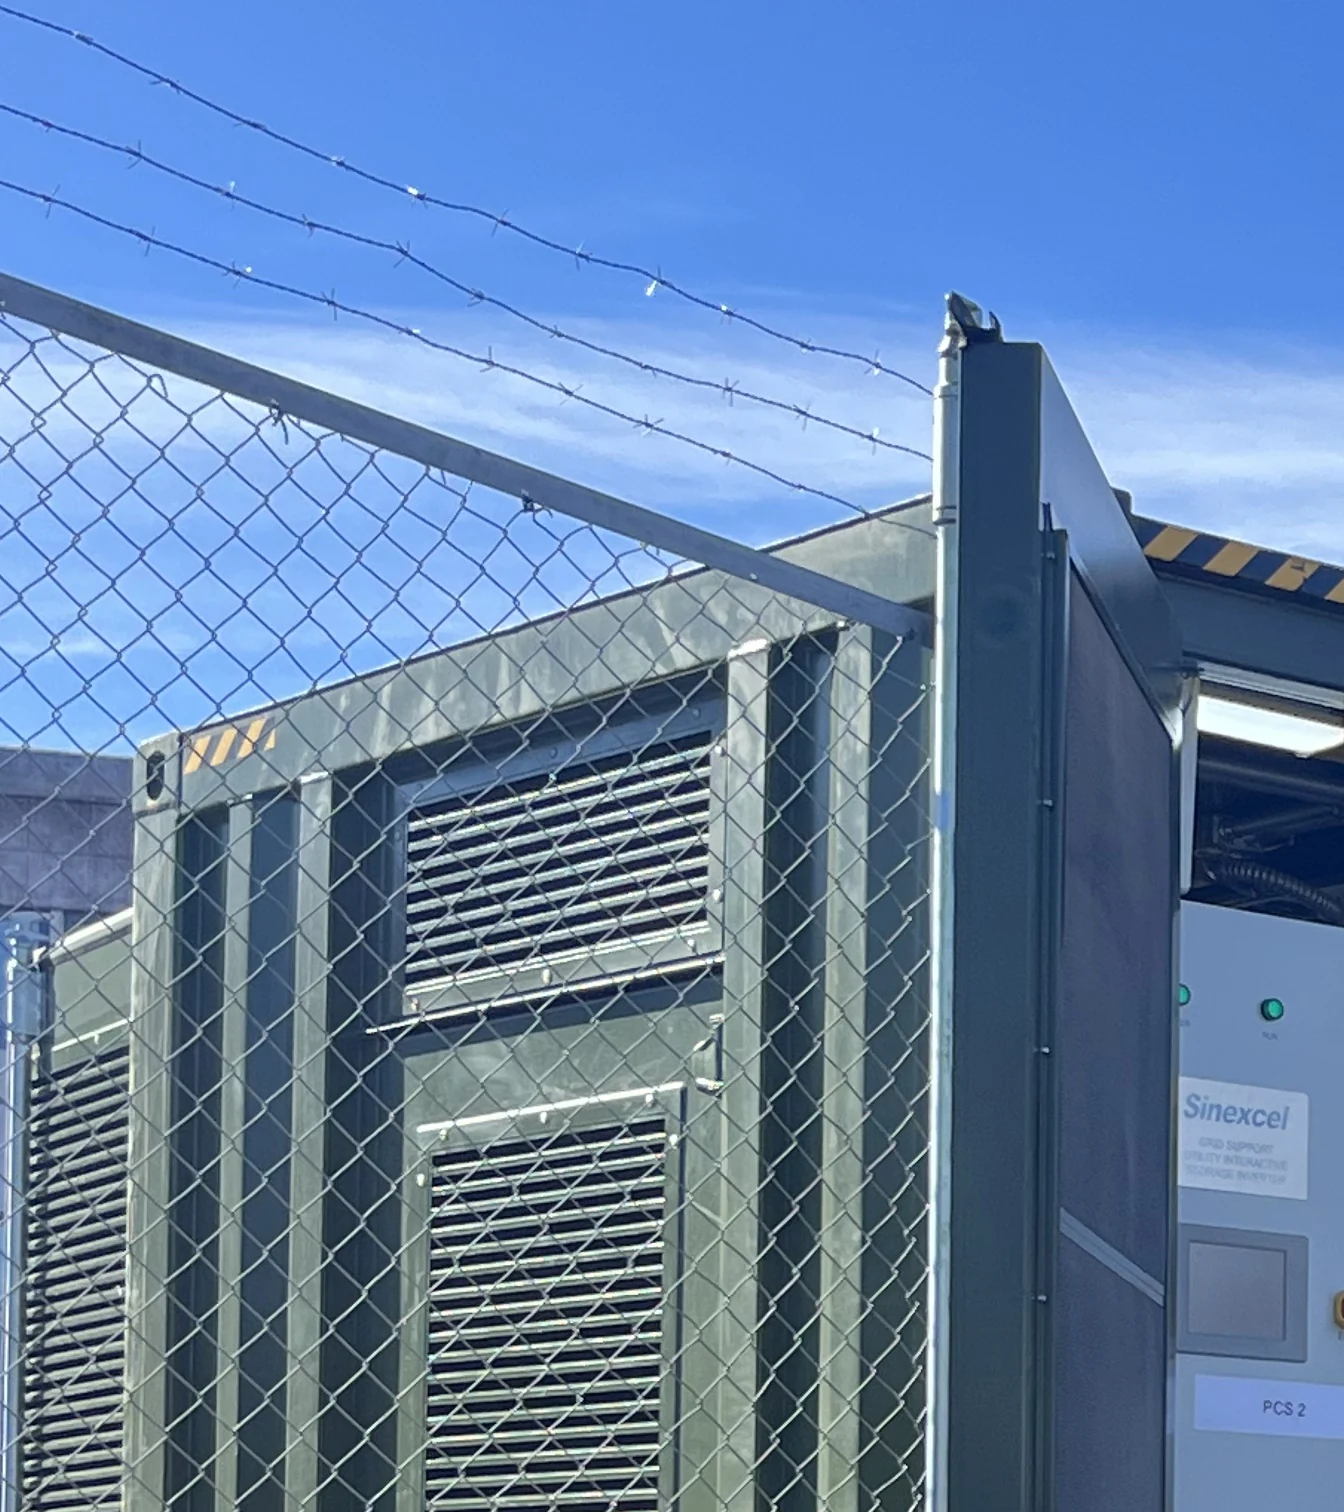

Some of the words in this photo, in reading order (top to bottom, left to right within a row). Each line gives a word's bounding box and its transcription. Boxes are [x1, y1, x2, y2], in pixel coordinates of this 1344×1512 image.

[1183, 1092, 1290, 1130] Sinexcel
[1263, 1399, 1294, 1416] PCS
[1297, 1402, 1307, 1418] 2
